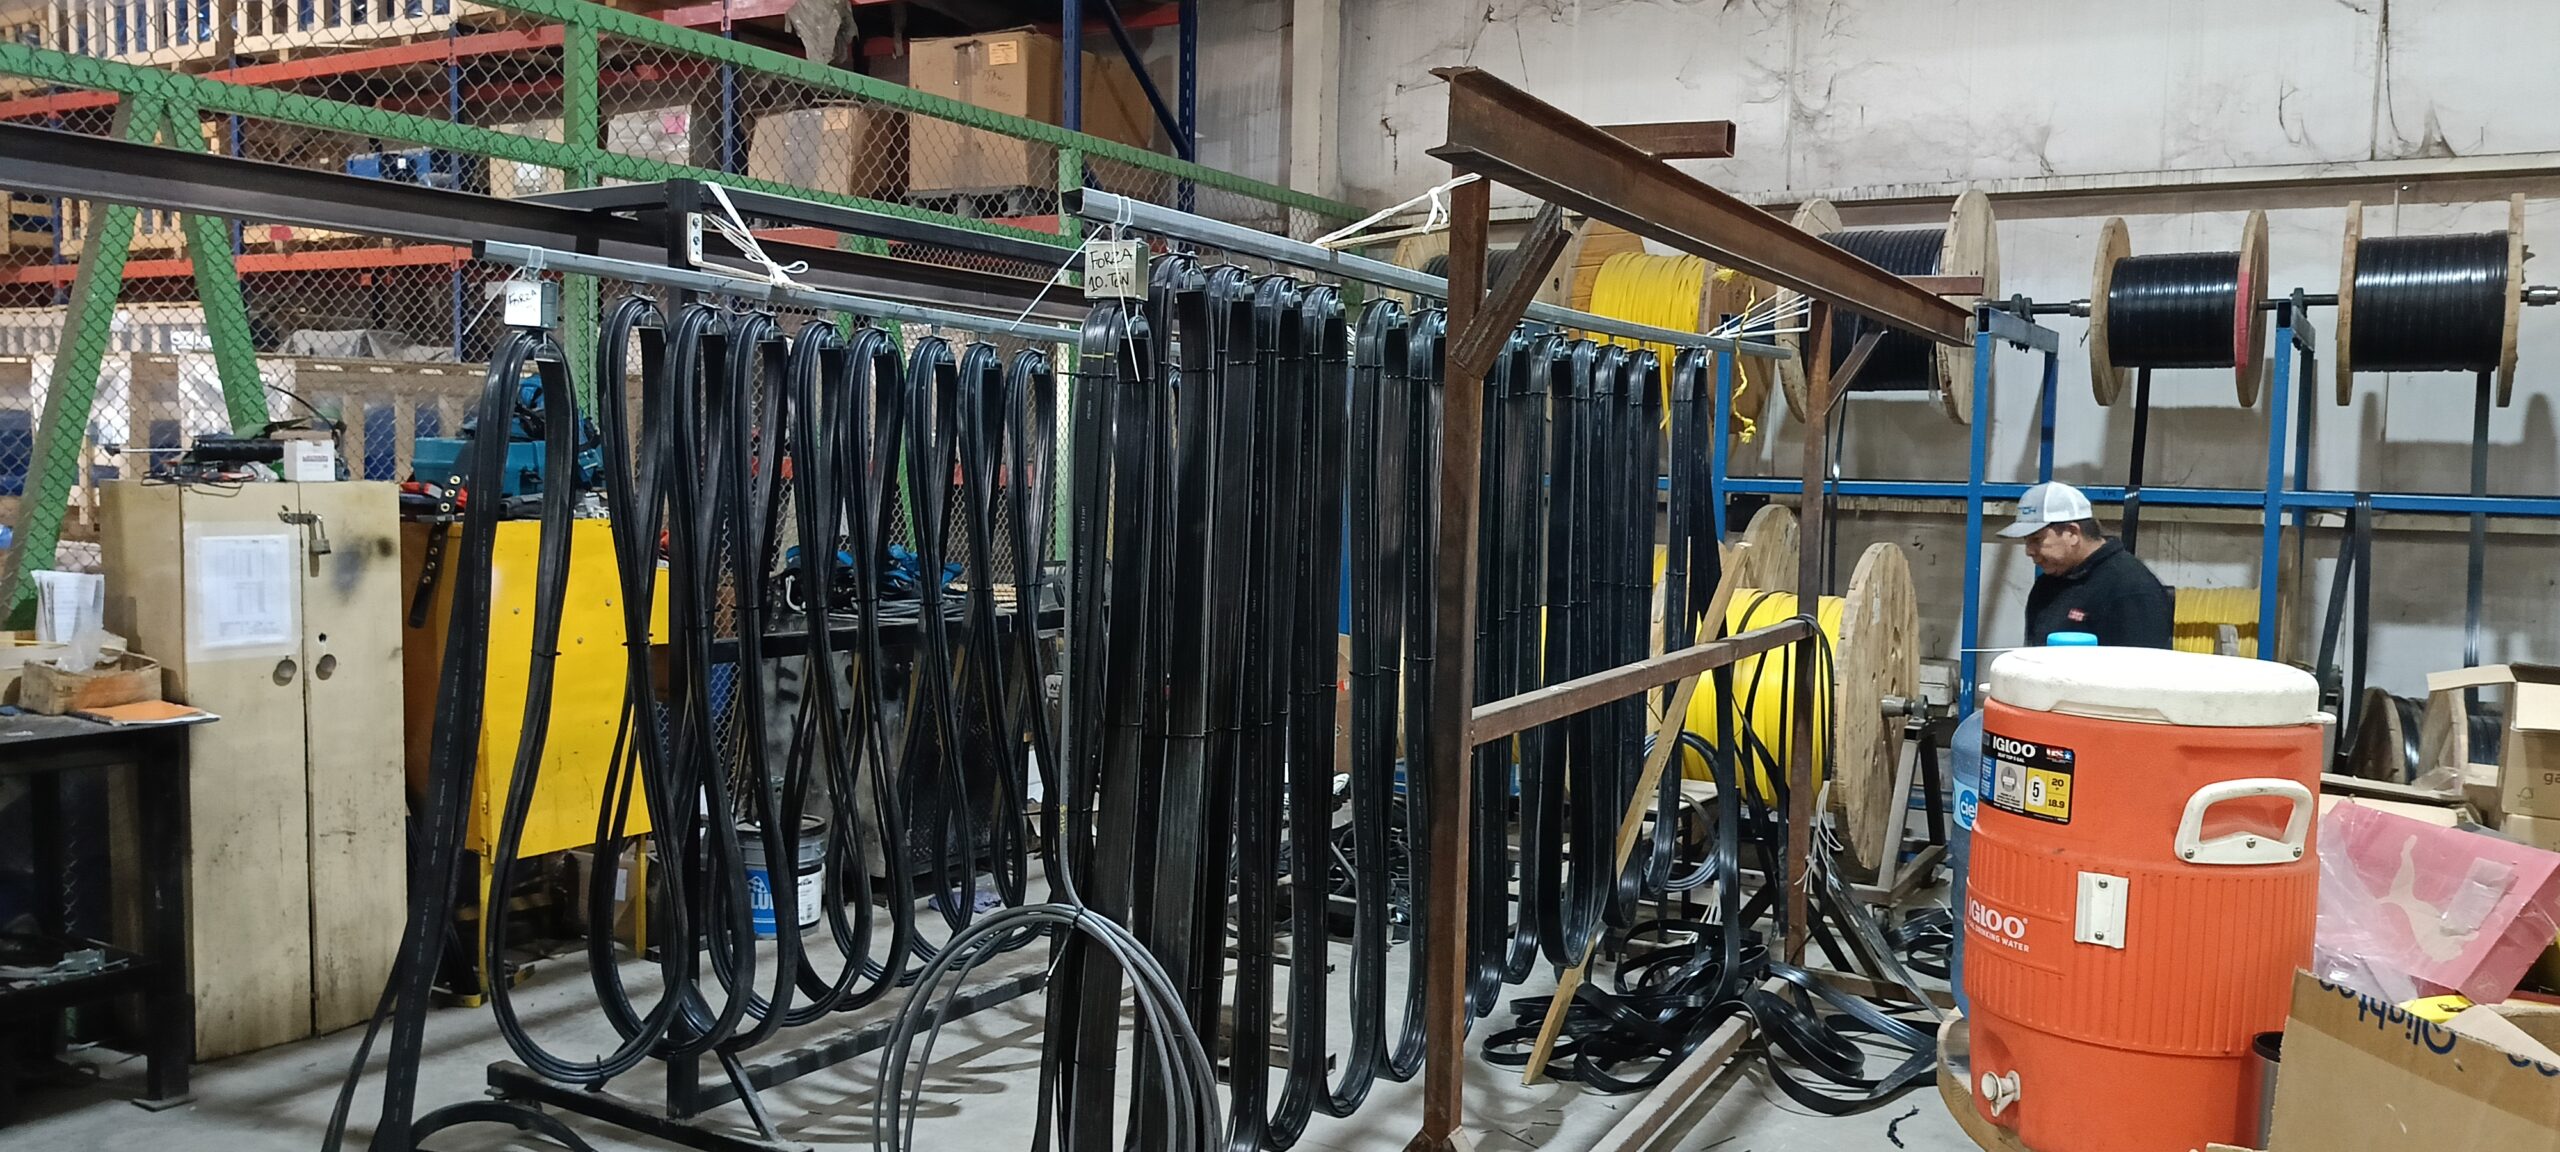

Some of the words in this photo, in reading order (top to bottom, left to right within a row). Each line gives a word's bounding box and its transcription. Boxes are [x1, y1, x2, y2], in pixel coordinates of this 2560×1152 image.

[1993, 736, 2036, 757] IGLOO
[2032, 781, 2040, 798] 5
[2051, 777, 2065, 788] 20
[2048, 798, 2066, 809] 18.9
[1969, 896, 2025, 939] IGLOO
[2001, 937, 2030, 953] WATER
